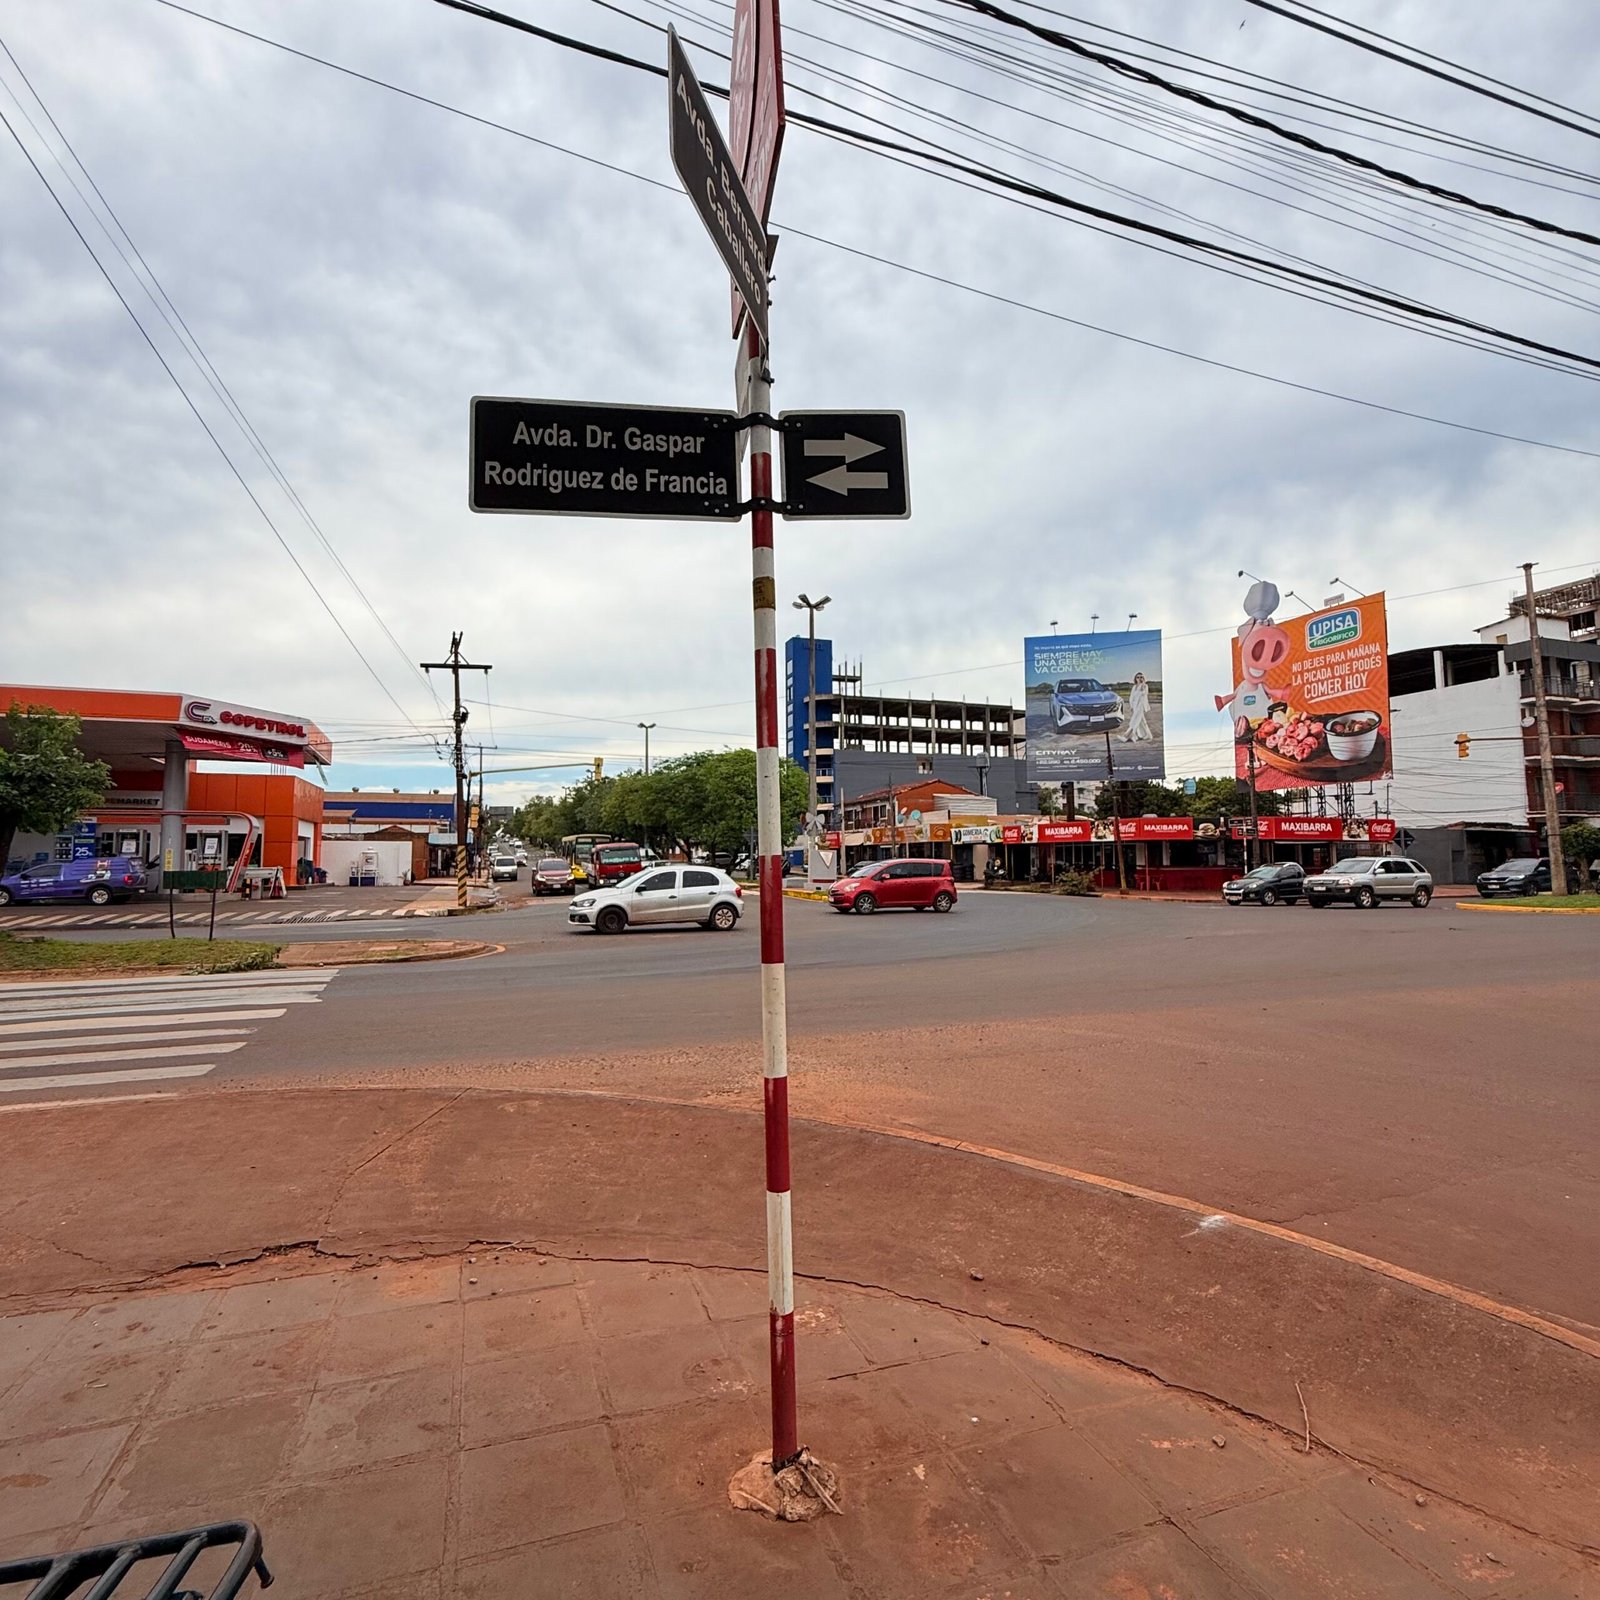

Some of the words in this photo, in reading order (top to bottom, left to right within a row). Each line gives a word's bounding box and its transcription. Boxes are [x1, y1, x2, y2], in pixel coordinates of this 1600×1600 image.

[676, 73, 718, 175] Avda.
[706, 176, 760, 304] Caballero
[513, 421, 578, 447] Avda.
[586, 424, 617, 449] Dr.
[624, 426, 705, 458] Gaspar
[484, 461, 604, 493] Rodriguez
[610, 467, 638, 491] de
[646, 469, 728, 495] Francia
[1312, 614, 1354, 636] UPISA
[1034, 651, 1079, 660] SIEMPRE
[1081, 650, 1103, 658] HAY
[1034, 659, 1057, 667] UNA
[1058, 657, 1091, 666] GEELY
[1292, 662, 1302, 673] NO
[1303, 656, 1325, 670] DEJES
[1326, 651, 1346, 665] PARA
[1347, 642, 1381, 660] MAÑANA
[1034, 666, 1049, 674] VA
[1050, 665, 1073, 673] CON
[1292, 675, 1302, 686] LA
[1303, 668, 1332, 684] PICADA
[1334, 662, 1351, 677] QUE
[1353, 655, 1382, 673] PODÉS
[1304, 678, 1342, 699] COMER
[1345, 671, 1369, 691] HOY
[220, 711, 307, 738] COPETROL
[185, 735, 232, 749] SUDAMERIS
[1044, 826, 1083, 836] MAXIBARRA
[1281, 822, 1333, 832] MAXIBARRA
